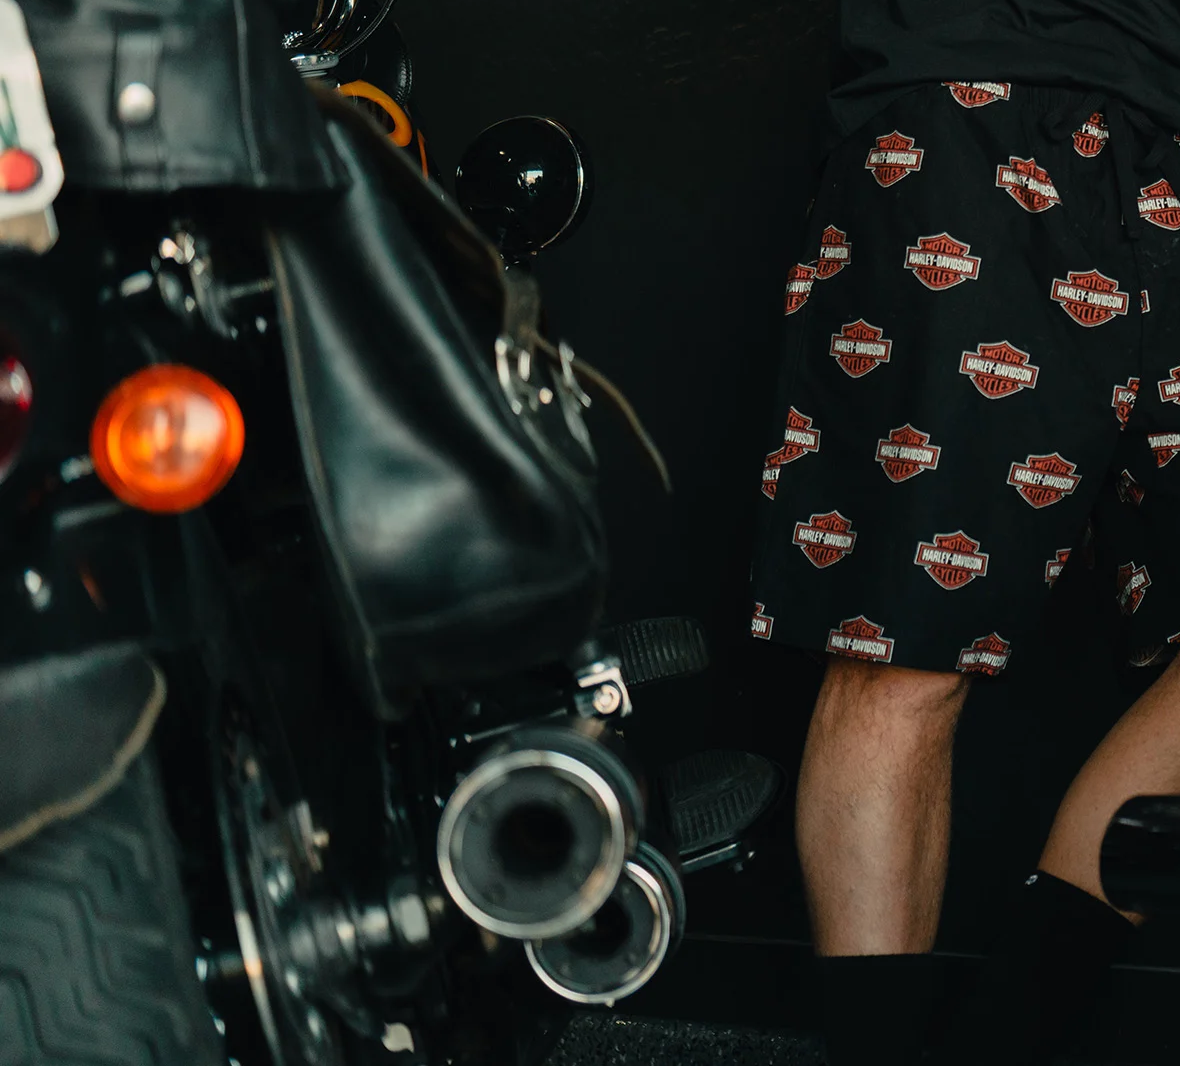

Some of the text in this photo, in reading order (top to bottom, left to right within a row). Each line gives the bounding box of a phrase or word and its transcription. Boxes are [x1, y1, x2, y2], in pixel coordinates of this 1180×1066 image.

[923, 239, 961, 255] MOTOR
[909, 252, 975, 274] HARLEY-DAVIDSON
[920, 268, 956, 284] CYCLES
[1075, 275, 1112, 292] MOTOR
[1056, 284, 1124, 310] HARLEY-DAVIDSON
[1069, 302, 1108, 321] CYCLES
[845, 327, 876, 341] MOTOR
[842, 356, 875, 372] CYCLES
[984, 346, 1022, 364] MOTOR
[966, 357, 1032, 383] HARLEY-DAVIDSON
[978, 374, 1014, 394] CYCLES
[1034, 458, 1067, 475] MOTOR
[1014, 469, 1076, 490] HARLEY-DAVIDSON
[1025, 485, 1058, 504] CYCLES
[816, 517, 847, 532] MOTOR
[798, 527, 853, 548] HARLEY-DAVIDSON
[940, 537, 974, 552] MOTOR
[809, 544, 838, 563] CYCLES
[921, 548, 984, 571] HARLEY-DAVIDSON
[934, 565, 967, 584] CYCLES
[831, 634, 888, 656] HARLEY-DAVIDSON
